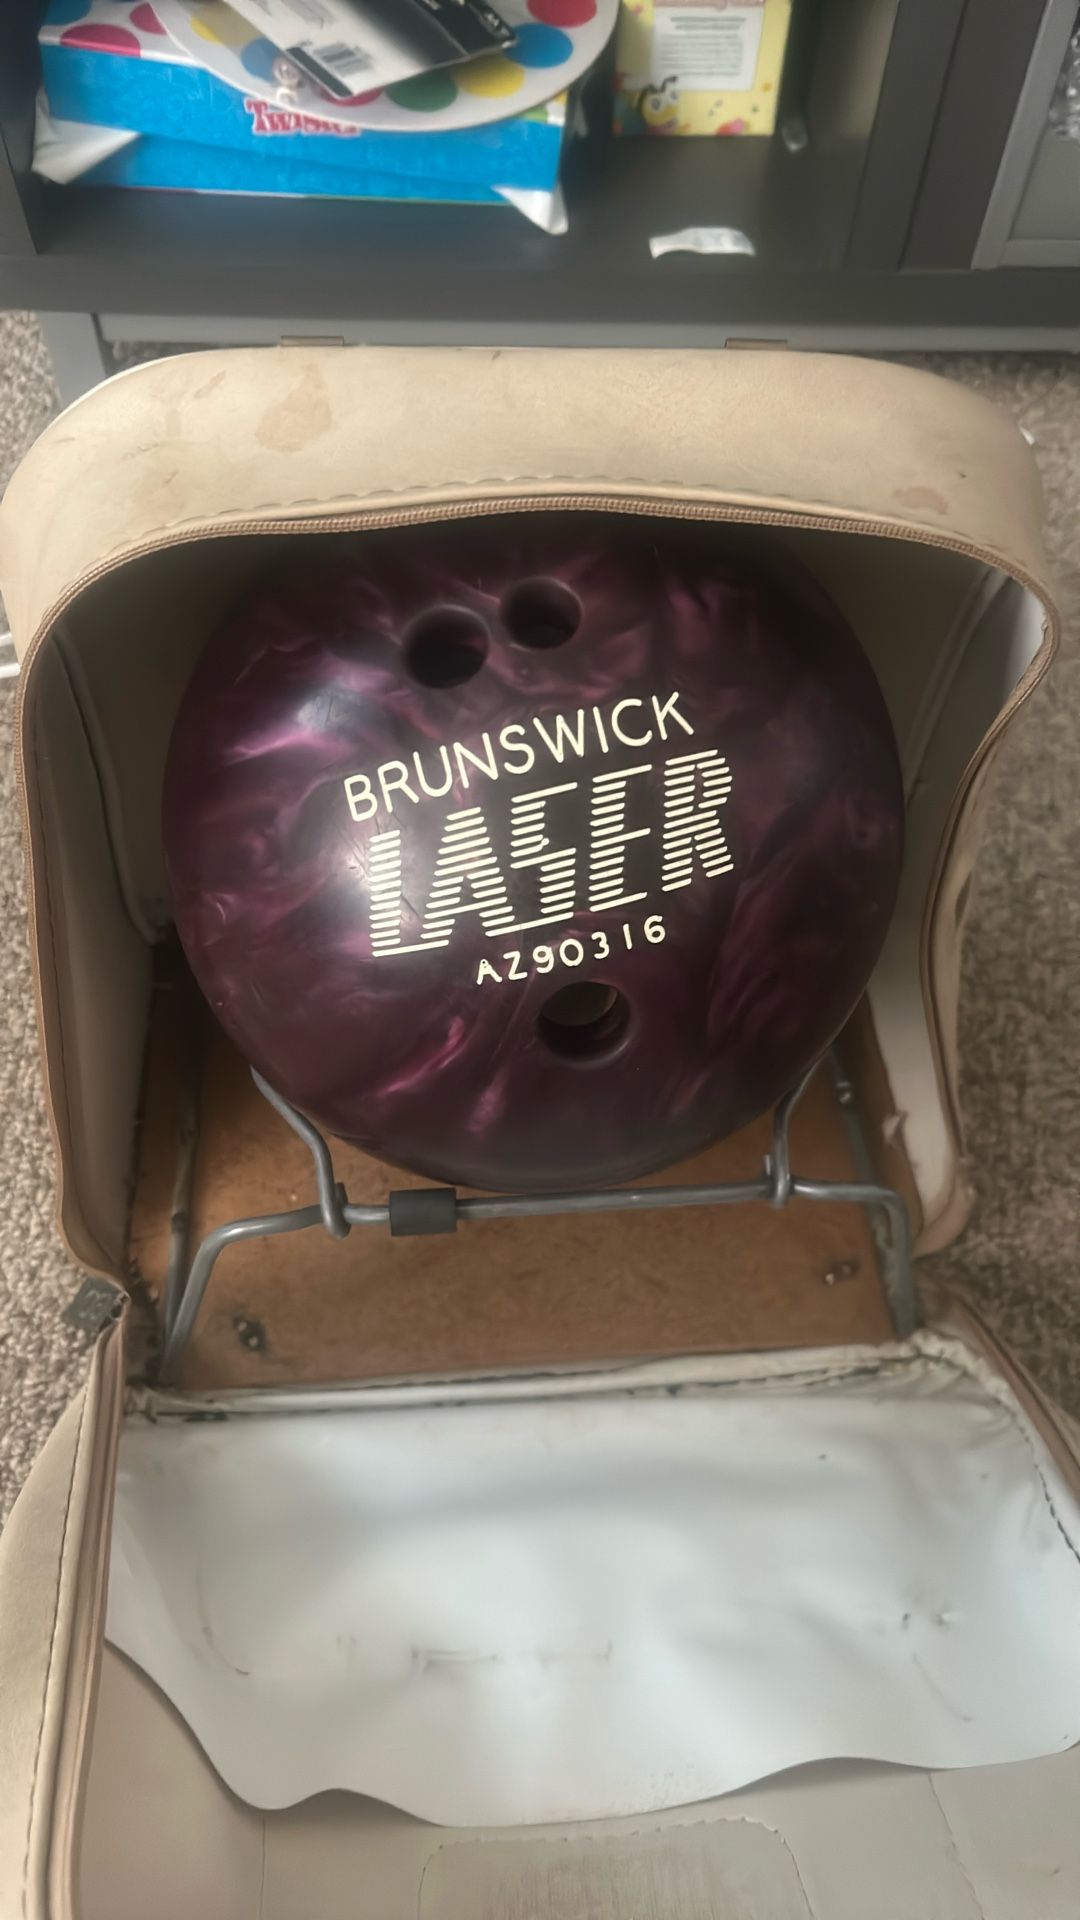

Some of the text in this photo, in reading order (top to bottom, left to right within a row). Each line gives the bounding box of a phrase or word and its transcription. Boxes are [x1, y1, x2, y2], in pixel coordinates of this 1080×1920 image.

[343, 691, 694, 821] BRUNSWICK
[368, 749, 733, 957] LASER
[476, 914, 666, 985] AZ90316
